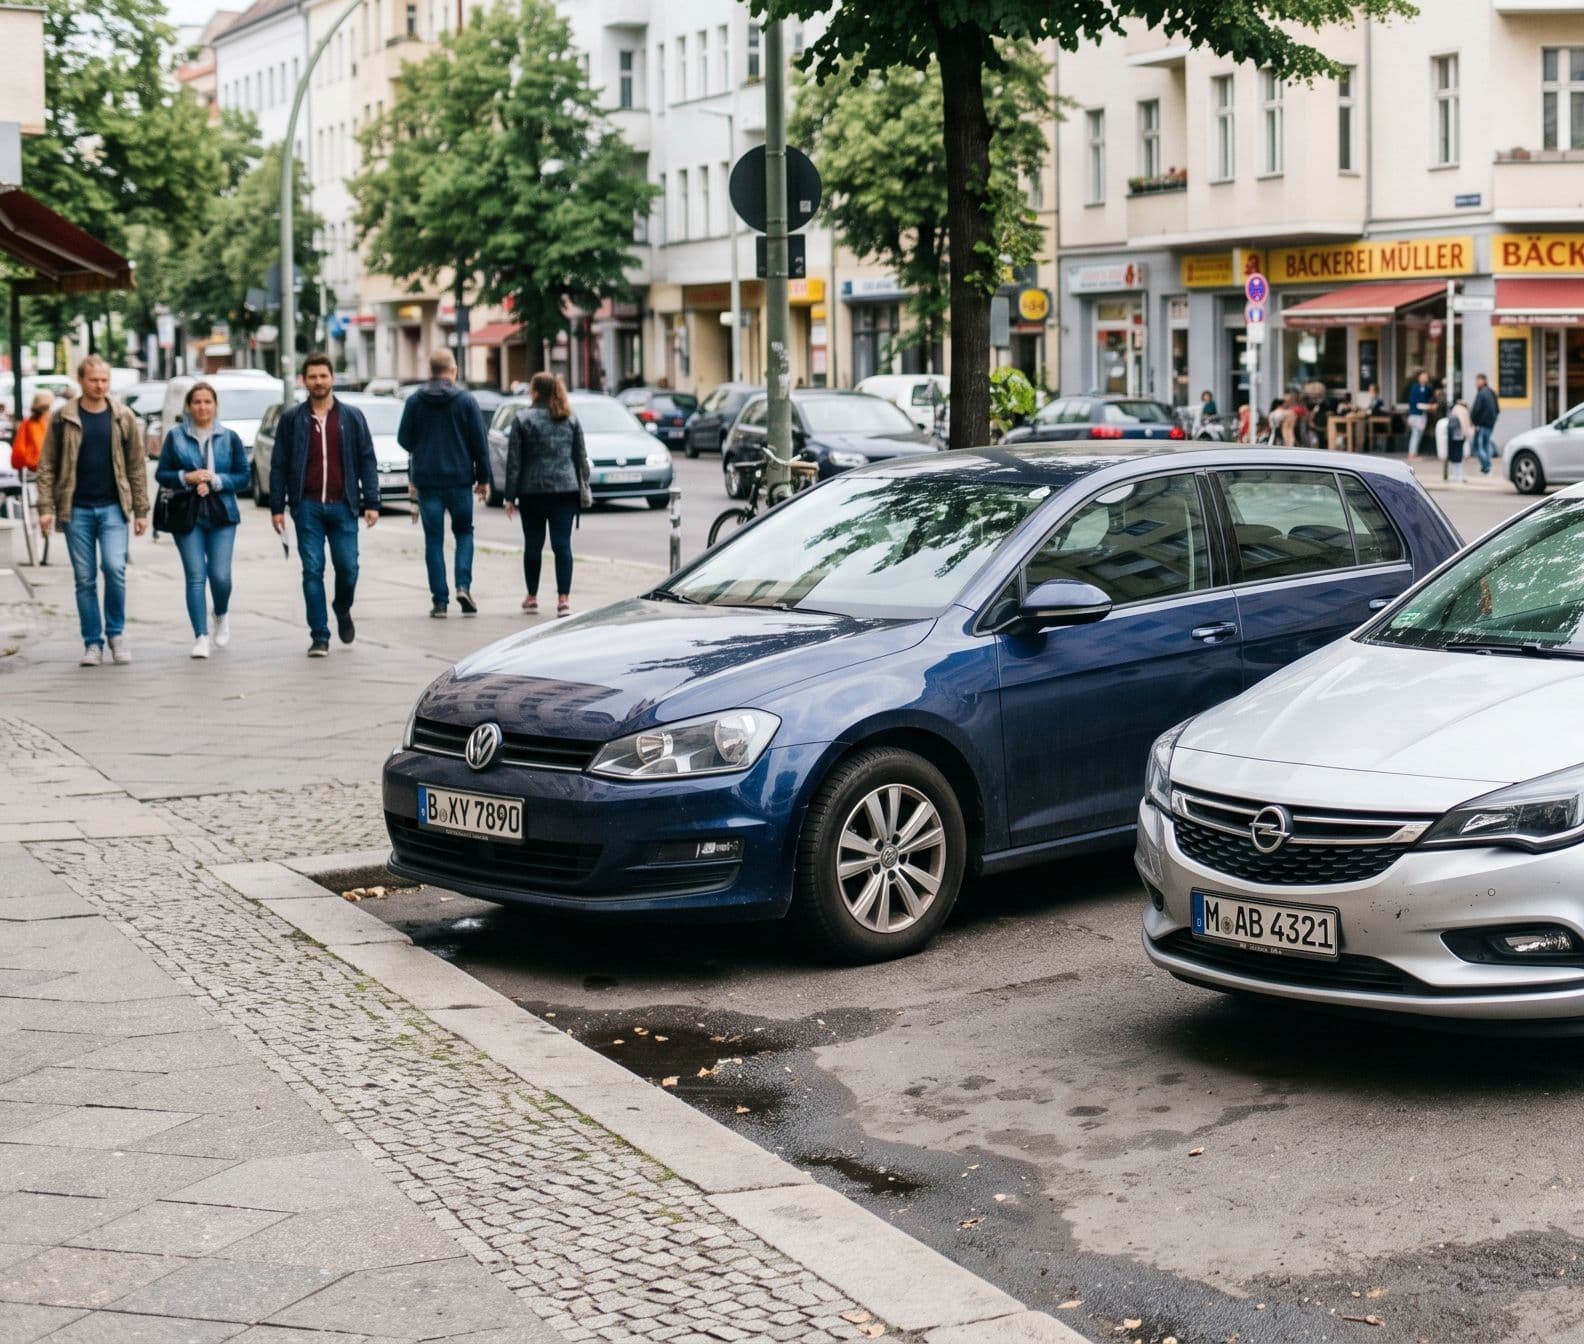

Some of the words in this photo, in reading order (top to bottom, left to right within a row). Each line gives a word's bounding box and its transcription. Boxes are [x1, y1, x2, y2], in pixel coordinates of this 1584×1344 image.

[1380, 241, 1464, 273] MÜLLER
[428, 793, 438, 820] B
[448, 796, 470, 826] XY
[475, 801, 520, 833] 7890
[1205, 900, 1219, 932] M
[1235, 906, 1263, 938] AB
[1270, 912, 1333, 949] 4321
